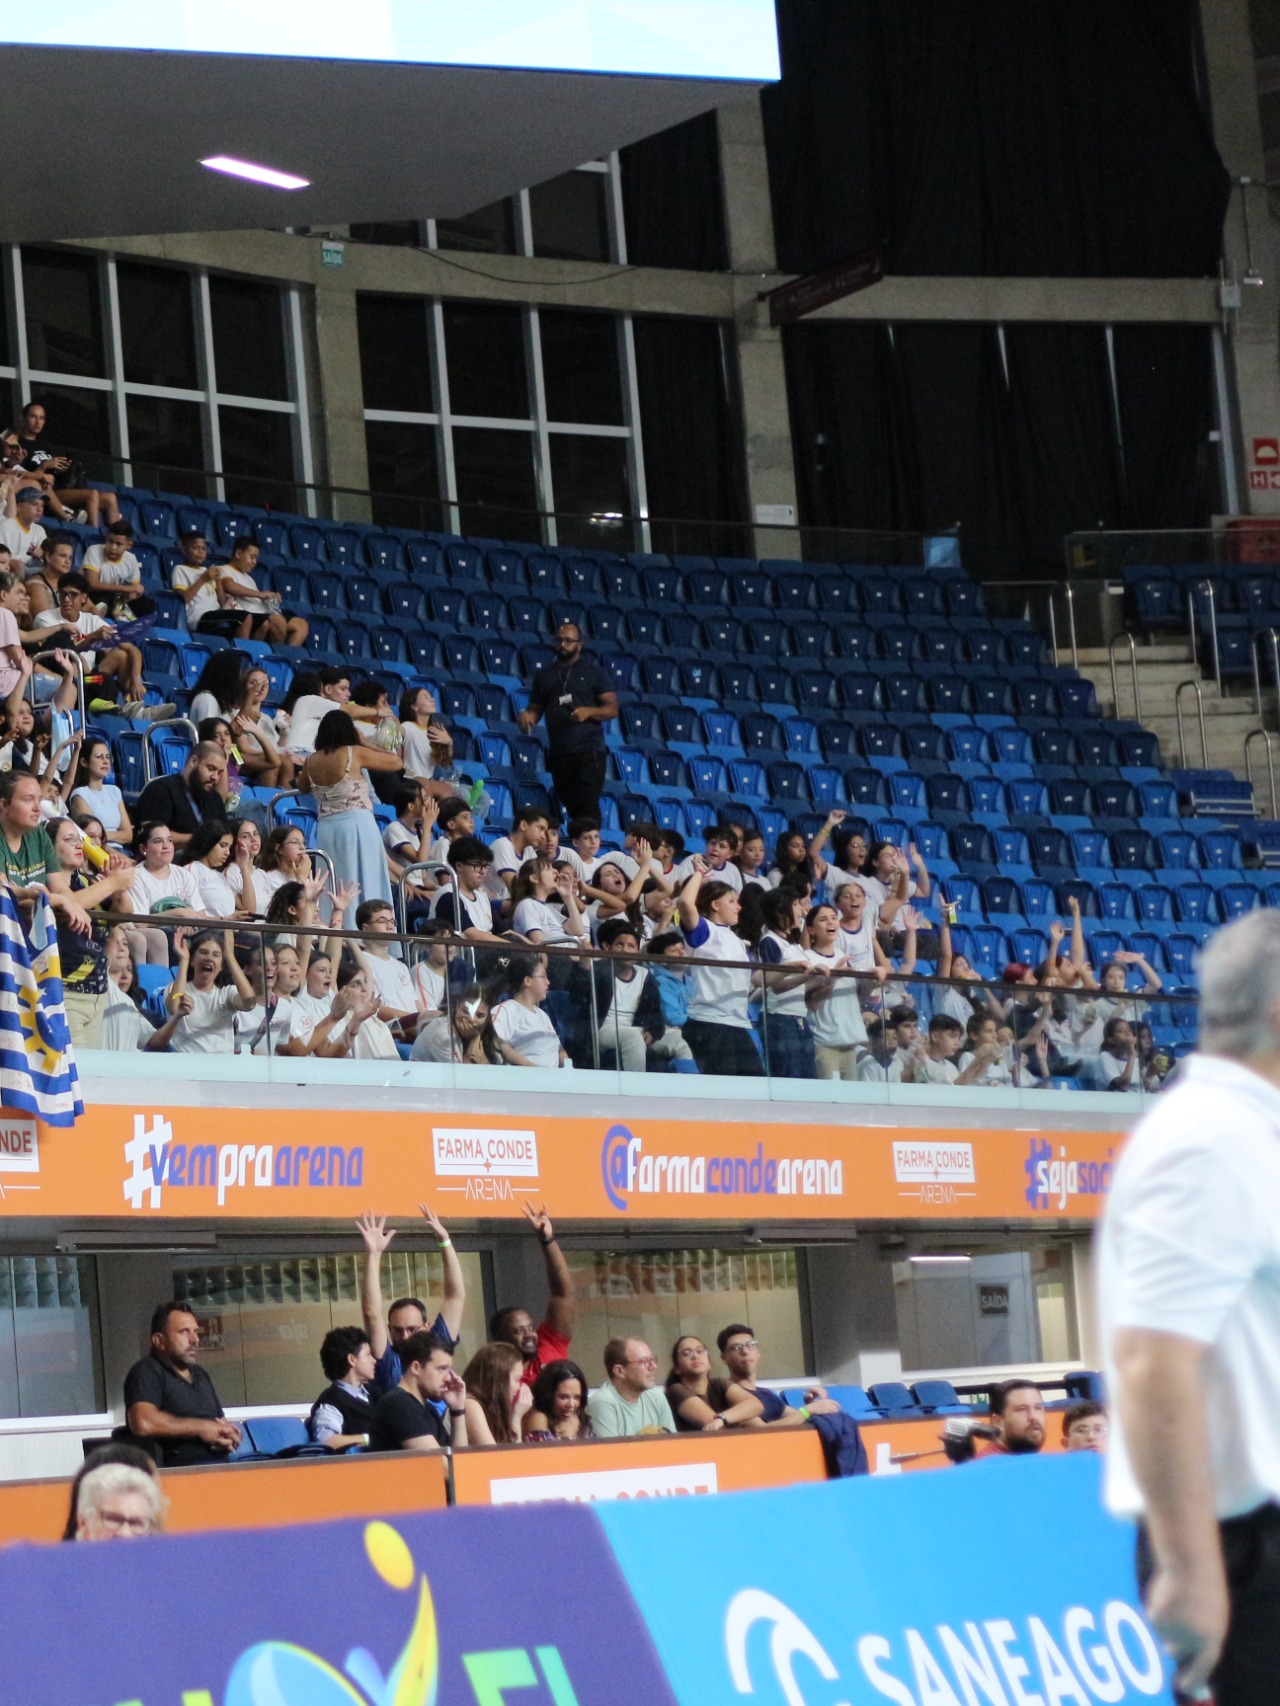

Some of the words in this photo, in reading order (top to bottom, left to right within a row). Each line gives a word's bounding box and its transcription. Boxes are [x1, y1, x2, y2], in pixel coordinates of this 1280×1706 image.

[437, 1138, 484, 1159] FARMA
[487, 1139, 533, 1160] CONDE
[897, 1150, 934, 1168] FARMA
[935, 1151, 971, 1169] CONDE
[465, 1178, 515, 1200] ARENA
[920, 1184, 958, 1204] ARENA
[858, 1600, 1163, 1706] SANEAGO
